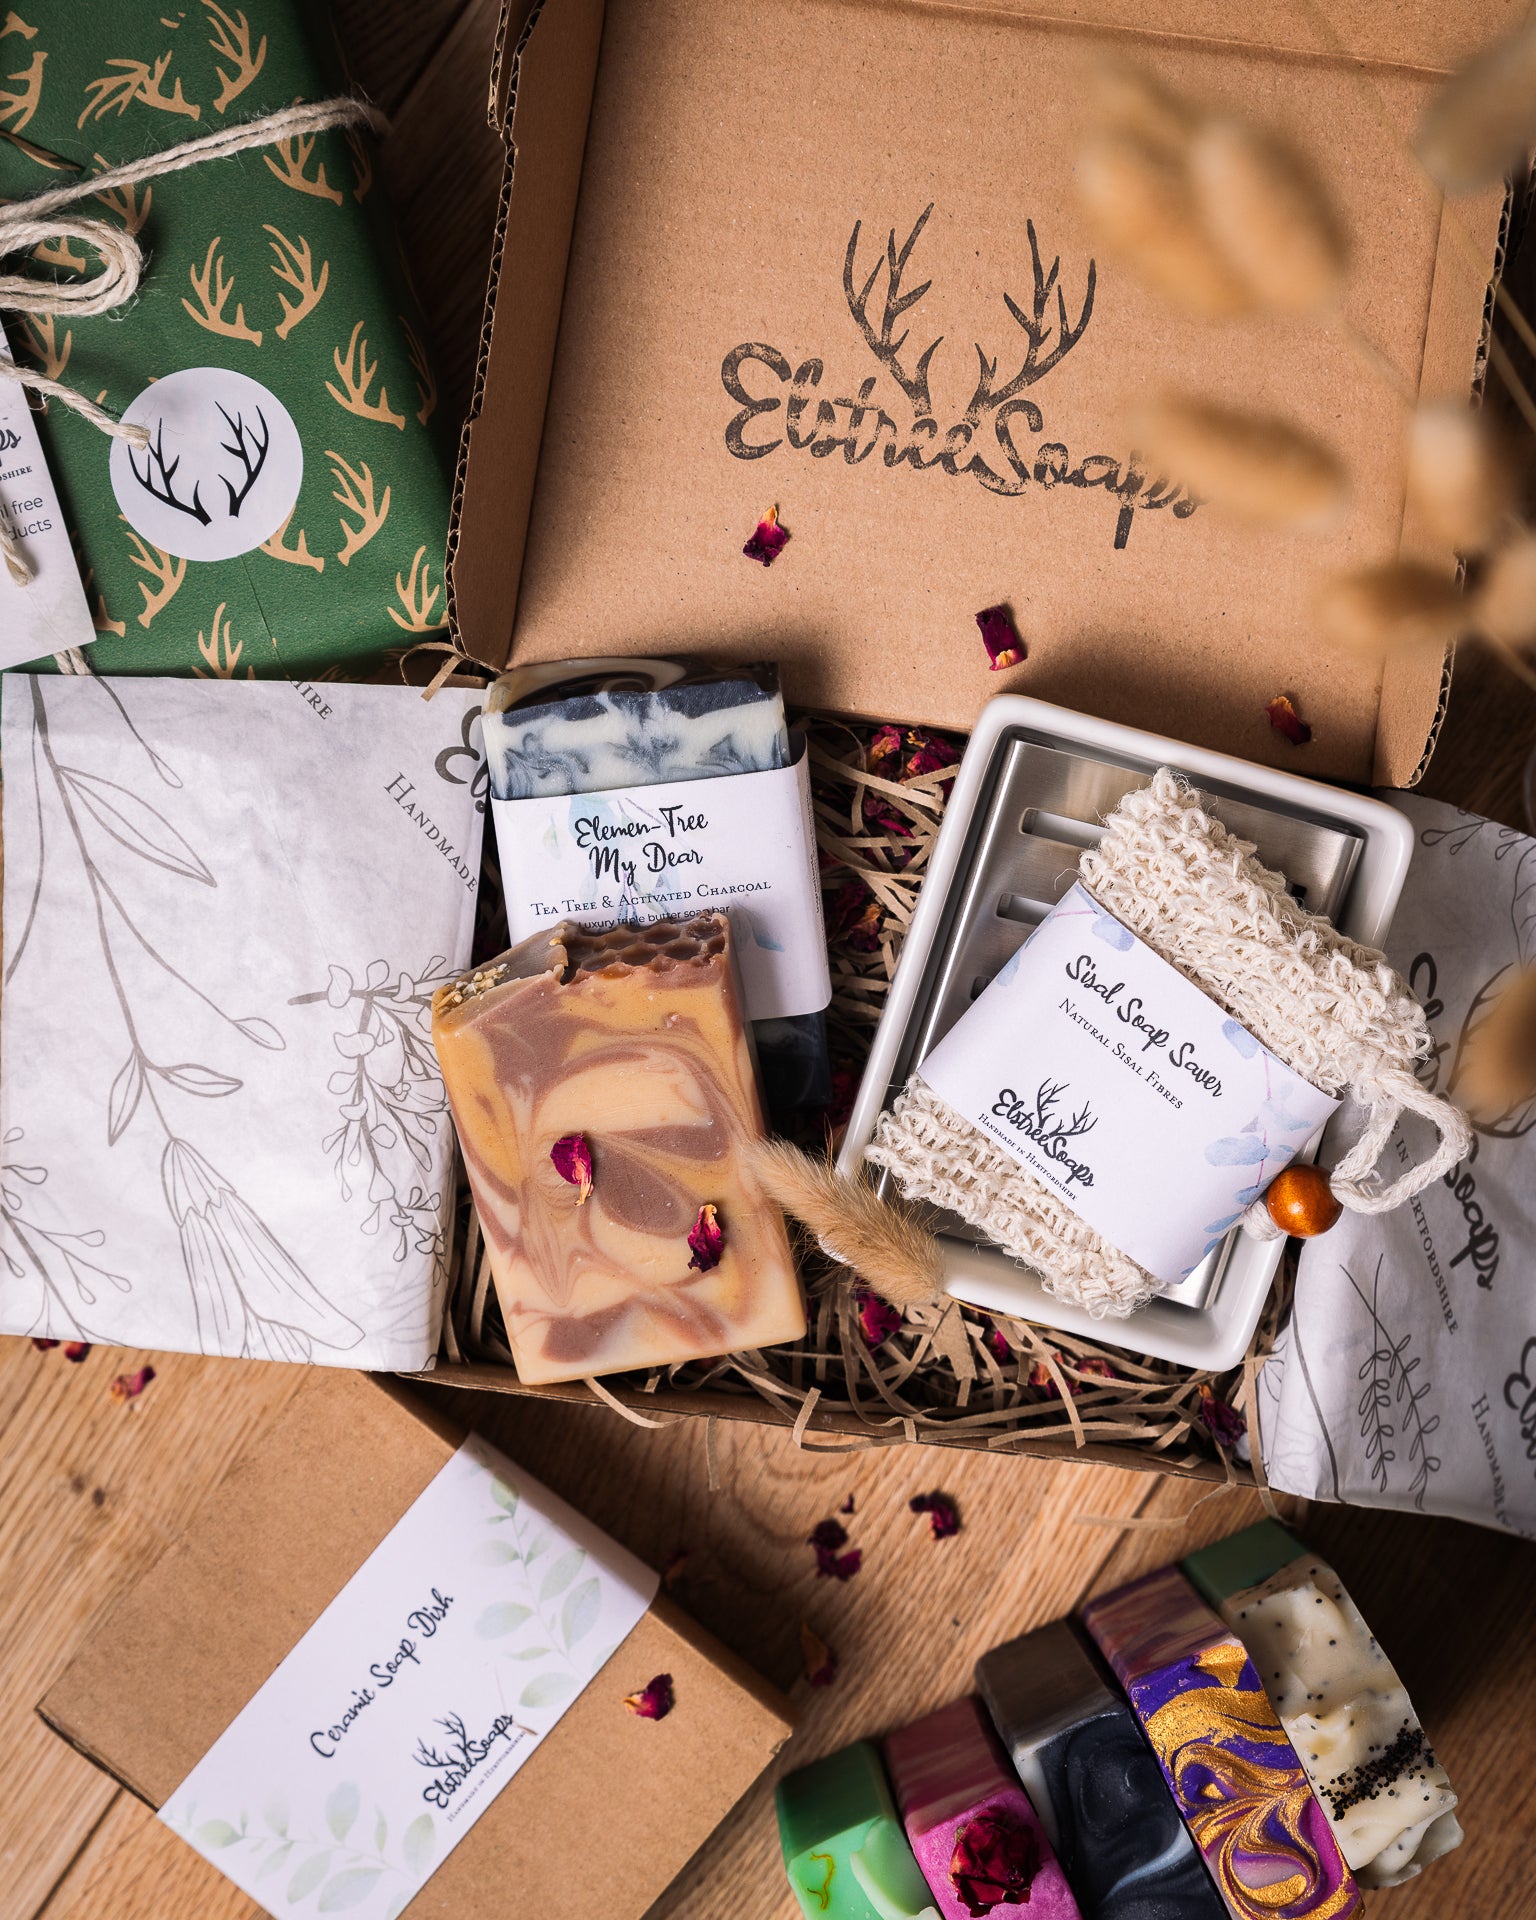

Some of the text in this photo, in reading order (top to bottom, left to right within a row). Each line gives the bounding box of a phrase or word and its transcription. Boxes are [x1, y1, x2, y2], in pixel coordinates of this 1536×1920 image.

[11, 497, 43, 515] free
[384, 771, 478, 892] HANDMADE
[574, 805, 708, 848] Elemen-Tree
[589, 842, 703, 886] My Dear
[531, 881, 772, 916] TEA TREE & ACTIVATED CHARCOAL
[648, 911, 681, 924] butter
[1058, 998, 1183, 1110] NATURAL SISAL FIBRES
[1066, 955, 1222, 1098] Sisal Soap Saver
[1396, 1139, 1459, 1335] IN ERTFORDSHIRE
[310, 1587, 454, 1758] Ceramic Soap Dish
